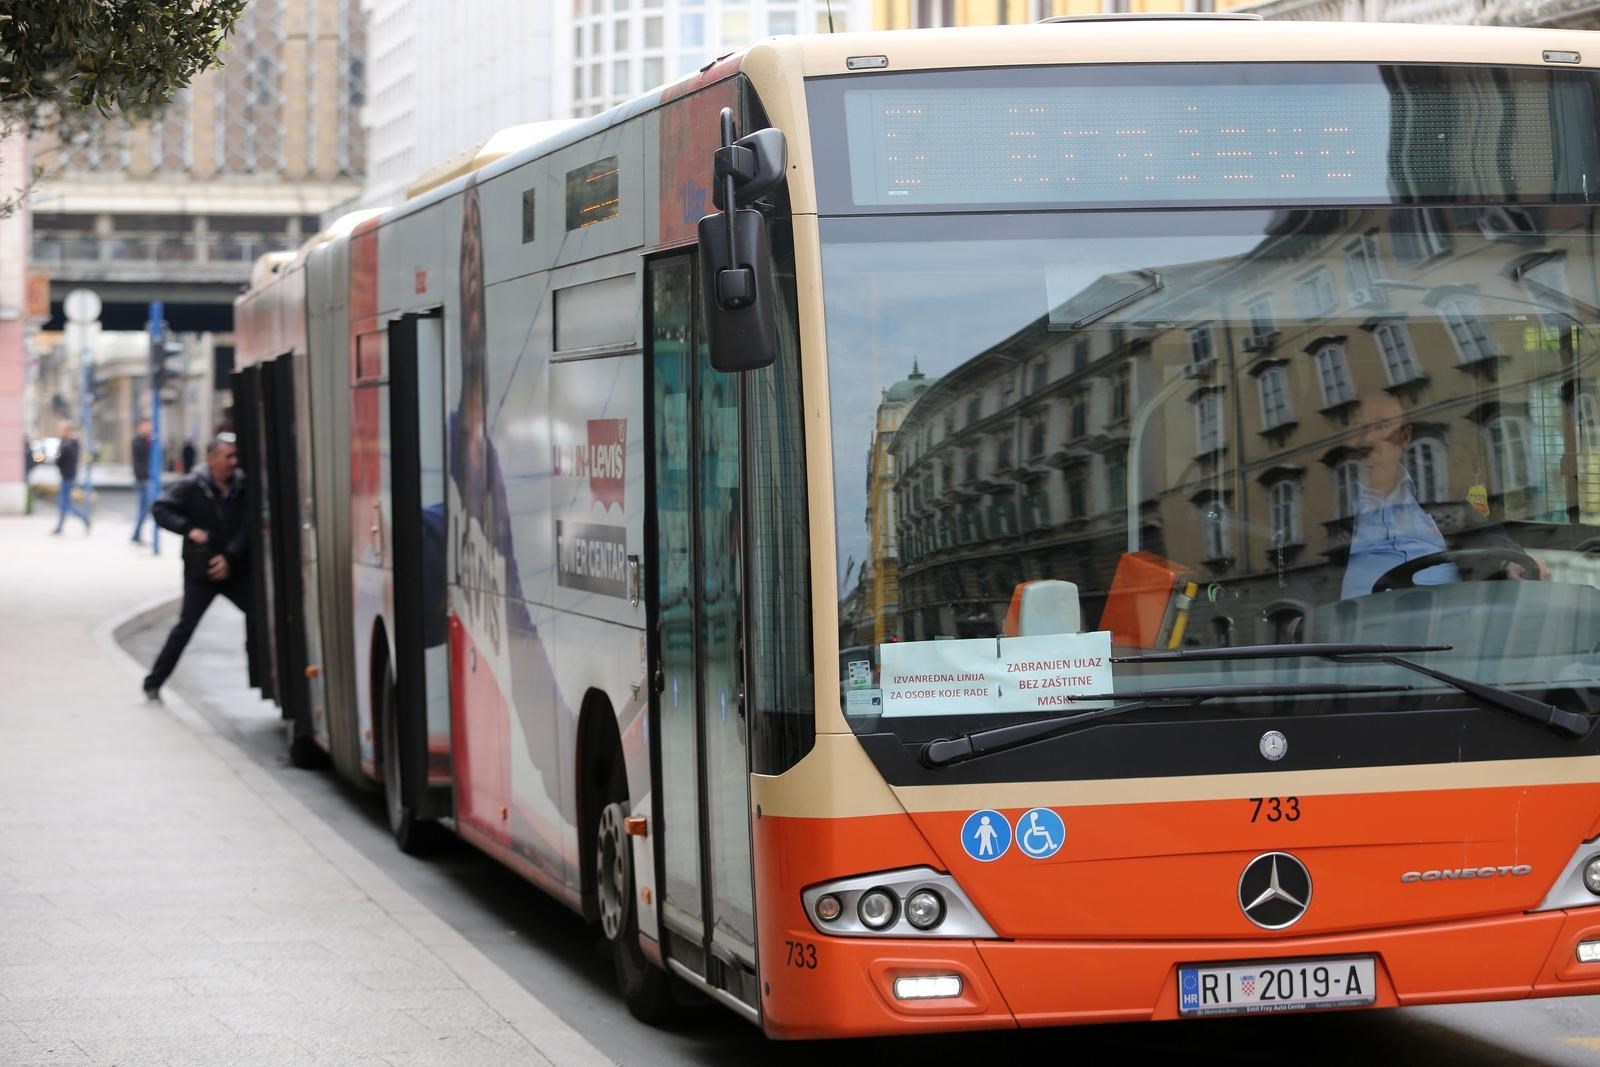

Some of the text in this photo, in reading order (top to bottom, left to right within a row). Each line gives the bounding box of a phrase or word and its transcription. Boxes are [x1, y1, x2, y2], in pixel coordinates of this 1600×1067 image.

[588, 539, 626, 583] CENTAR
[1006, 657, 1102, 673] ZABRANJEN ULAZ
[893, 673, 985, 684] IZVANREDNA LINIJA
[1019, 675, 1092, 690] BEZ ZAŠTITNE
[890, 687, 989, 700] ZA OSOBE KOJE RADE
[1248, 796, 1301, 823] 733
[1401, 864, 1532, 883] CONECTO
[785, 940, 818, 970] 733
[1202, 965, 1362, 1004] RI 2019-A
[1184, 994, 1198, 1004] HR
